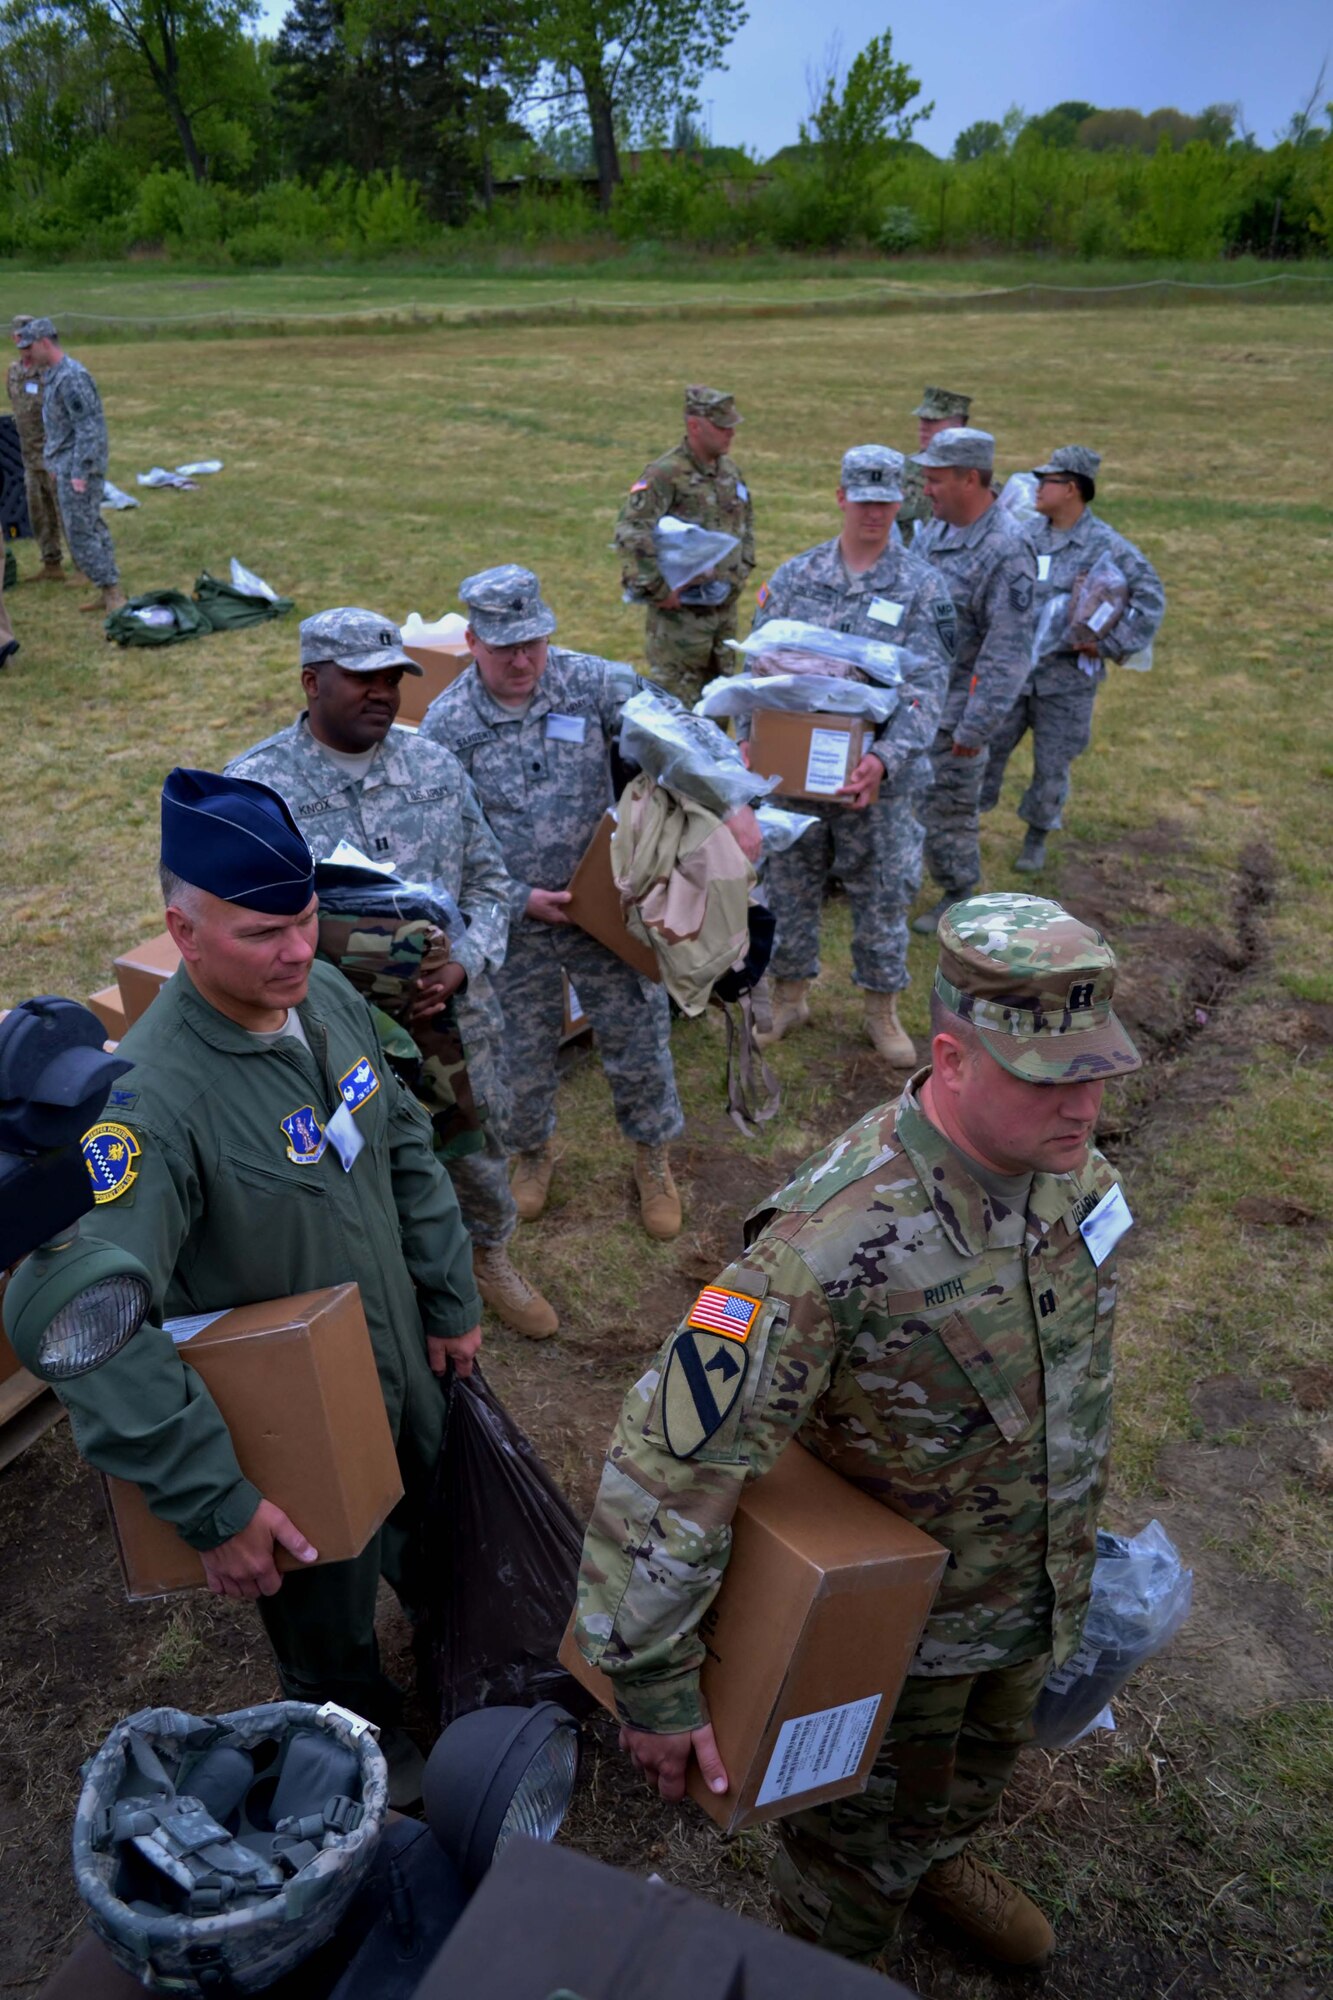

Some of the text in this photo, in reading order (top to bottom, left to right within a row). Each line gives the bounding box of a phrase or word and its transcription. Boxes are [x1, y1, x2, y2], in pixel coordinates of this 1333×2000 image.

[937, 605, 953, 617] MP
[427, 785, 449, 799] ARMY
[298, 799, 331, 816] KNOX
[924, 1278, 965, 1307] RUTH
